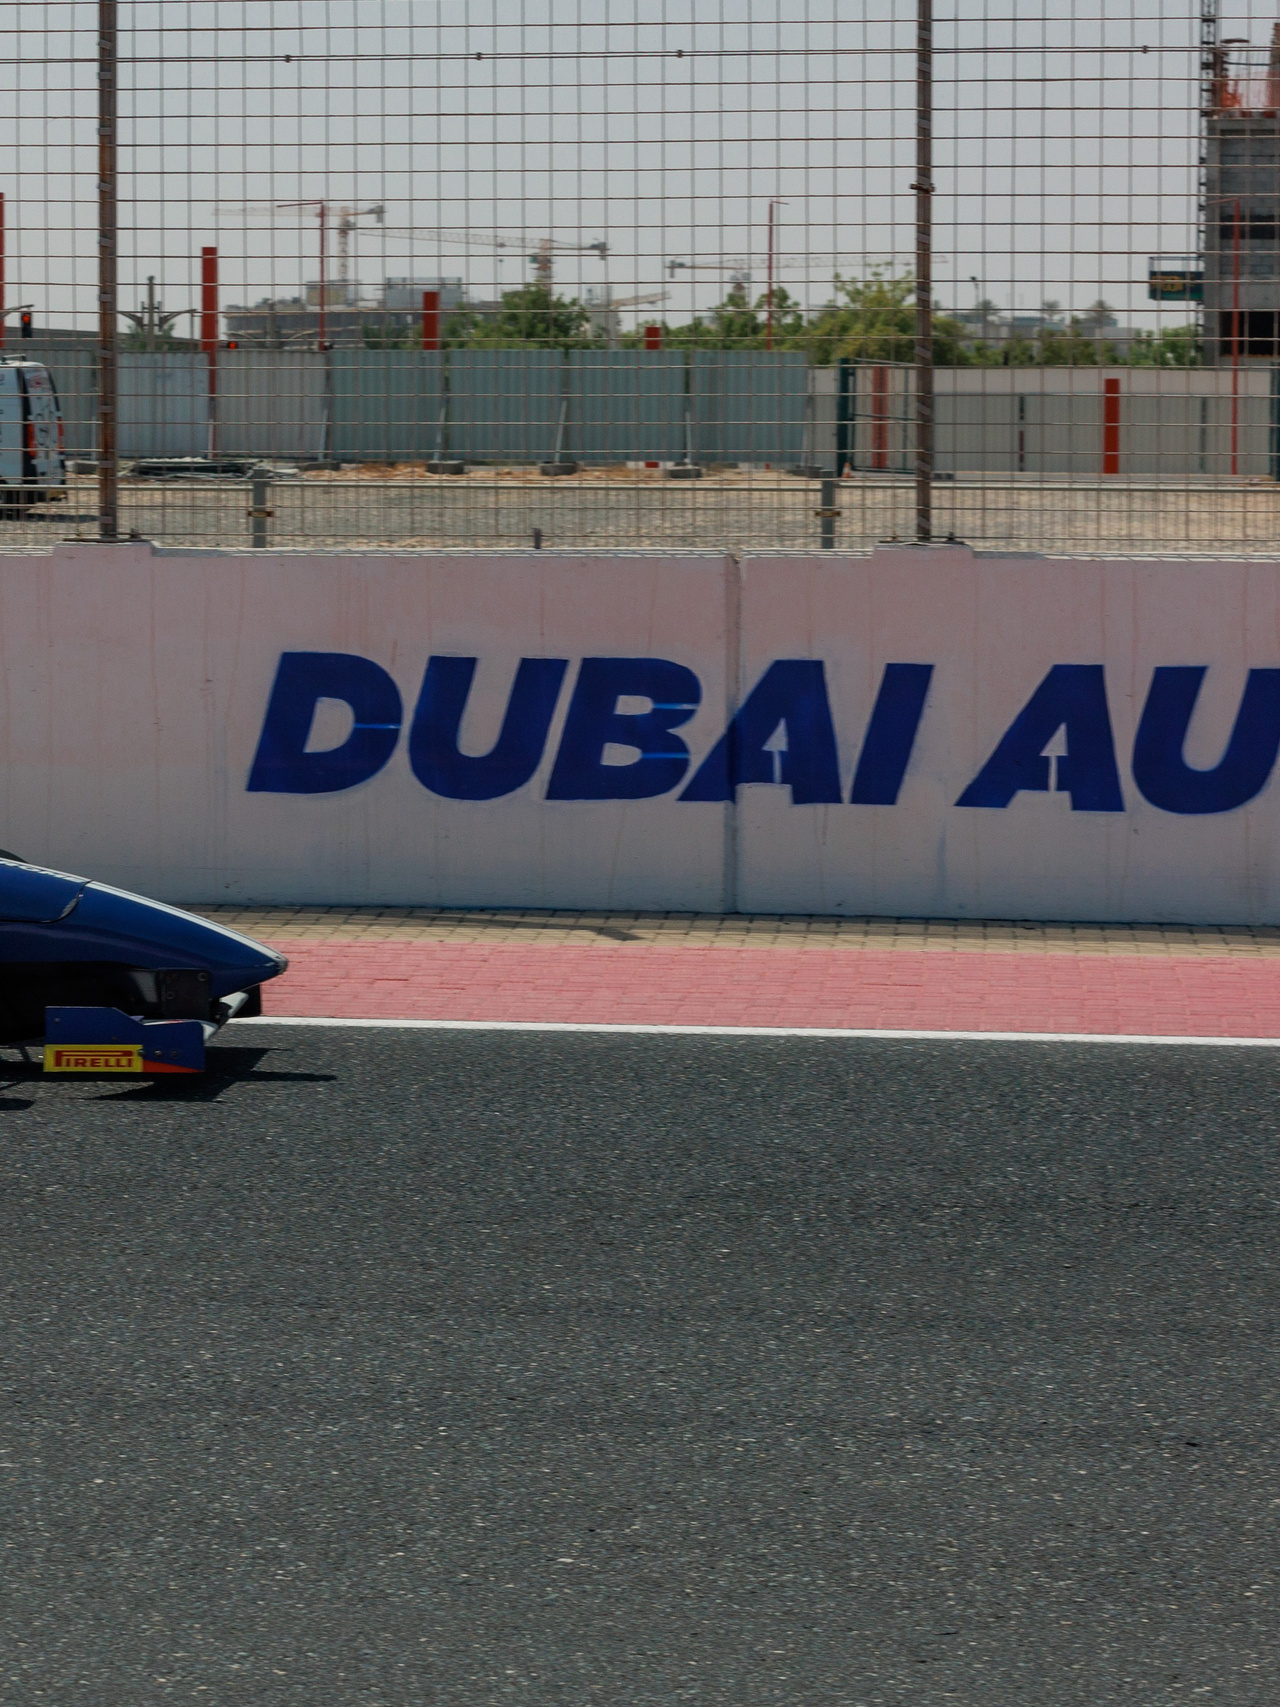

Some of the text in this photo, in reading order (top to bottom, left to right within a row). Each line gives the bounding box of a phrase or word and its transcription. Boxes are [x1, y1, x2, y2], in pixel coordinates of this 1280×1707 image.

[246, 651, 1280, 815] DUBAI AU
[54, 1049, 134, 1068] PIRELLI
